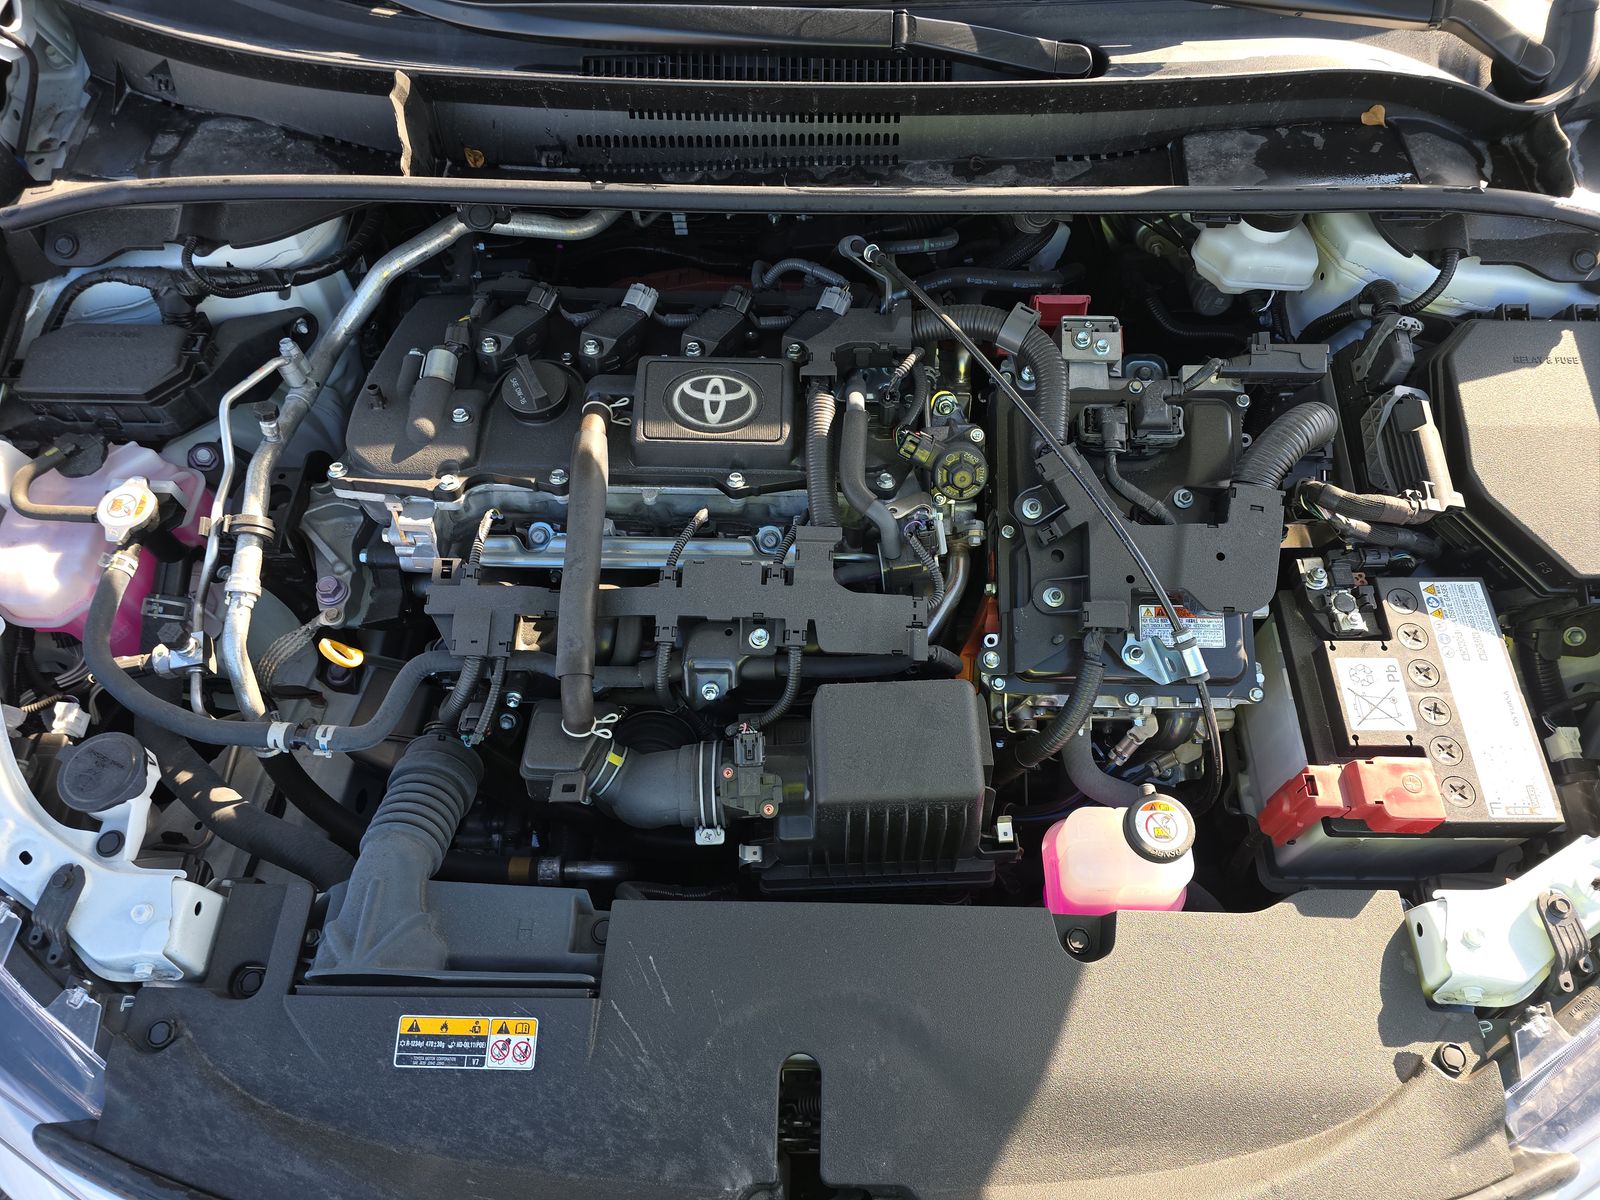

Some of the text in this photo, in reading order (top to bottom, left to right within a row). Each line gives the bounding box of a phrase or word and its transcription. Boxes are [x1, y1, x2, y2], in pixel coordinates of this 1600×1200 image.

[1513, 355, 1543, 364] RELAY
[1554, 356, 1579, 365] FUSE
[509, 377, 520, 388] SAE
[1439, 583, 1451, 601] GASES
[1385, 664, 1400, 683] Pb
[1150, 847, 1182, 858] DENSO
